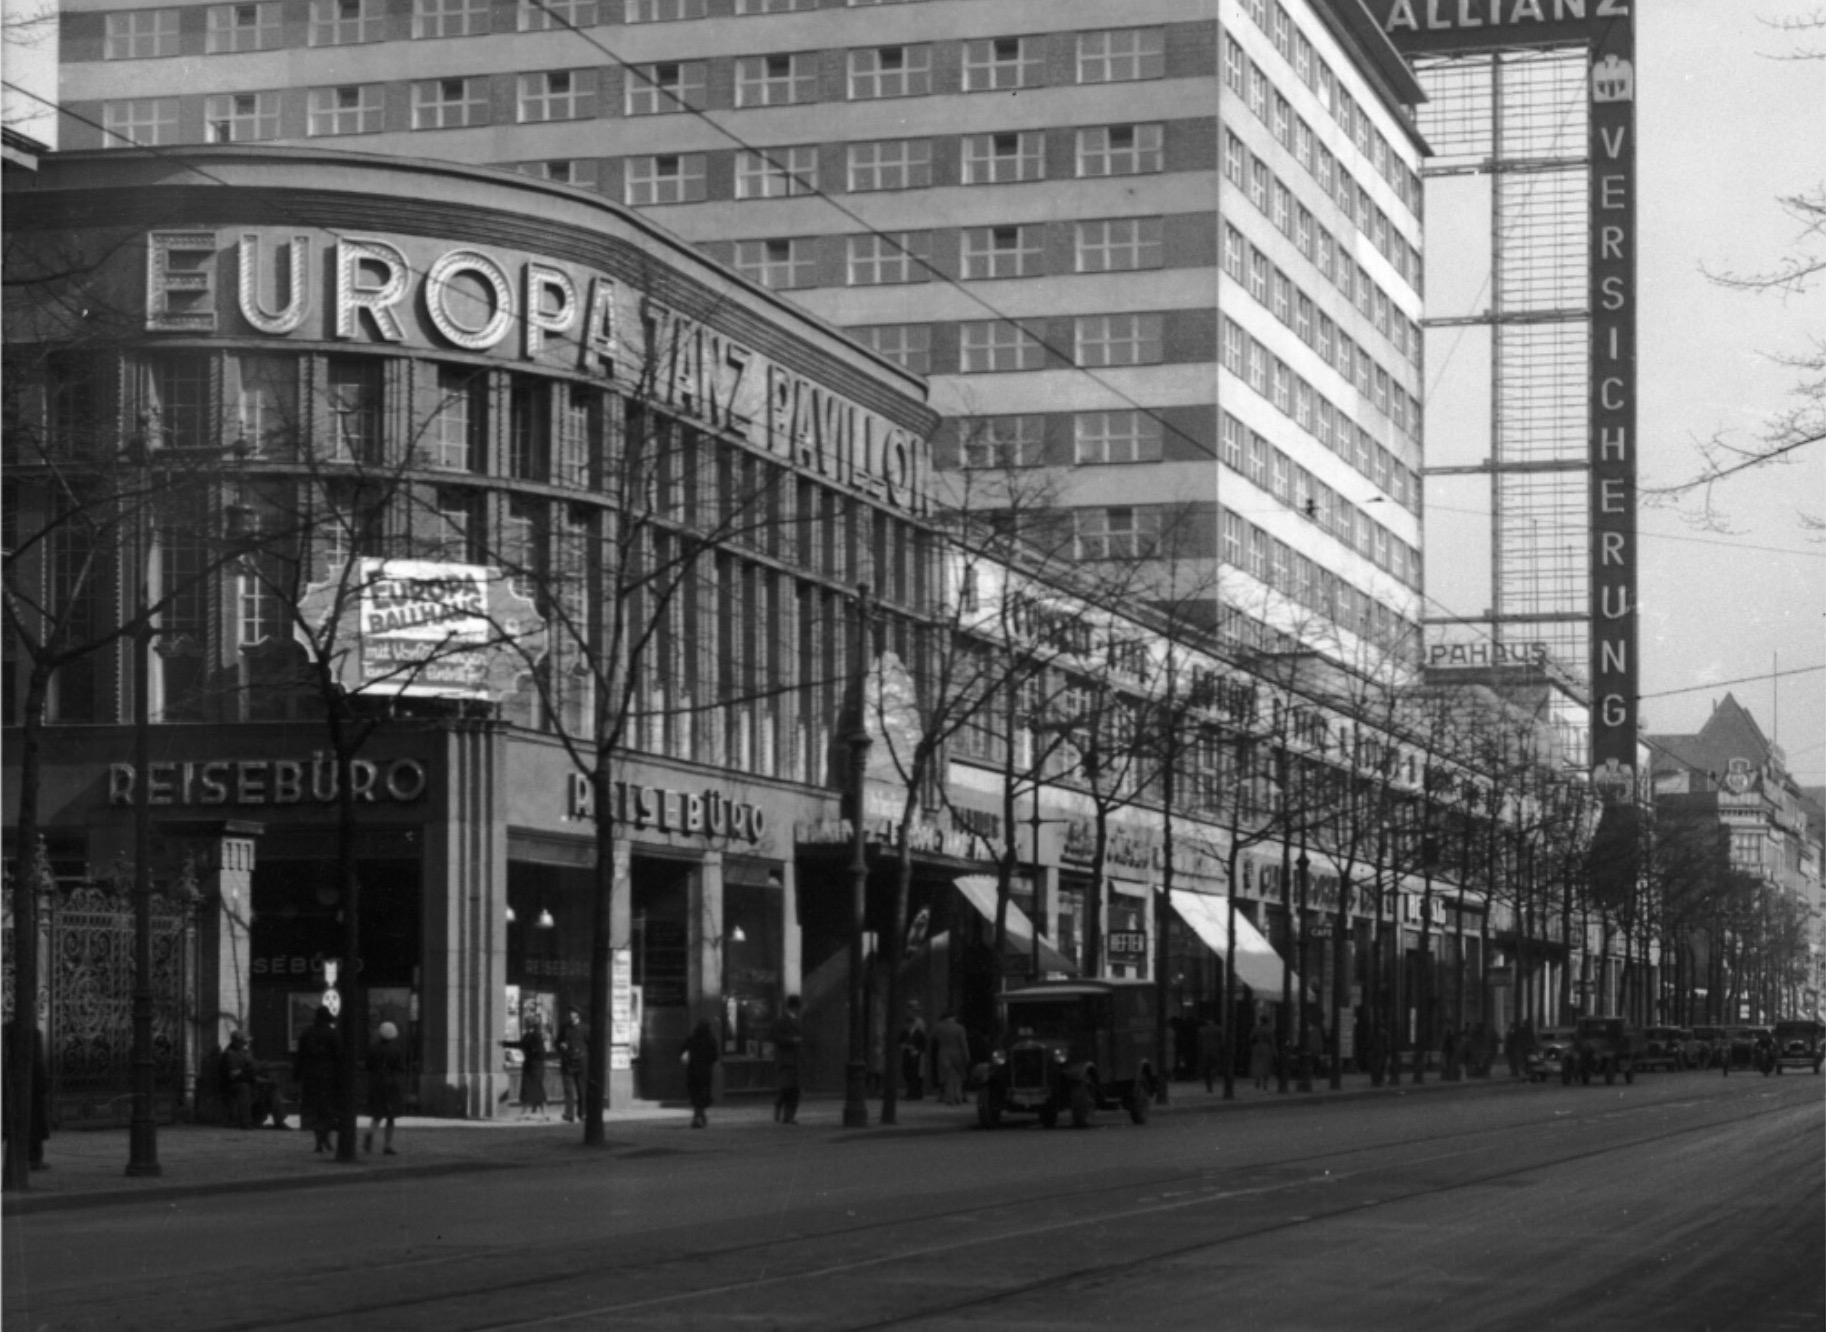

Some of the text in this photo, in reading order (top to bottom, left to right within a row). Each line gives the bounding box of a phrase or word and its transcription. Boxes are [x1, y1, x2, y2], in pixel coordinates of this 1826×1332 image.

[146, 230, 615, 378] EUROPA
[642, 296, 752, 438] TANZ
[1601, 126, 1627, 727] VERSICHERUNG
[108, 750, 426, 806] REISEBÜRO
[568, 773, 766, 845] RISEBÜRO
